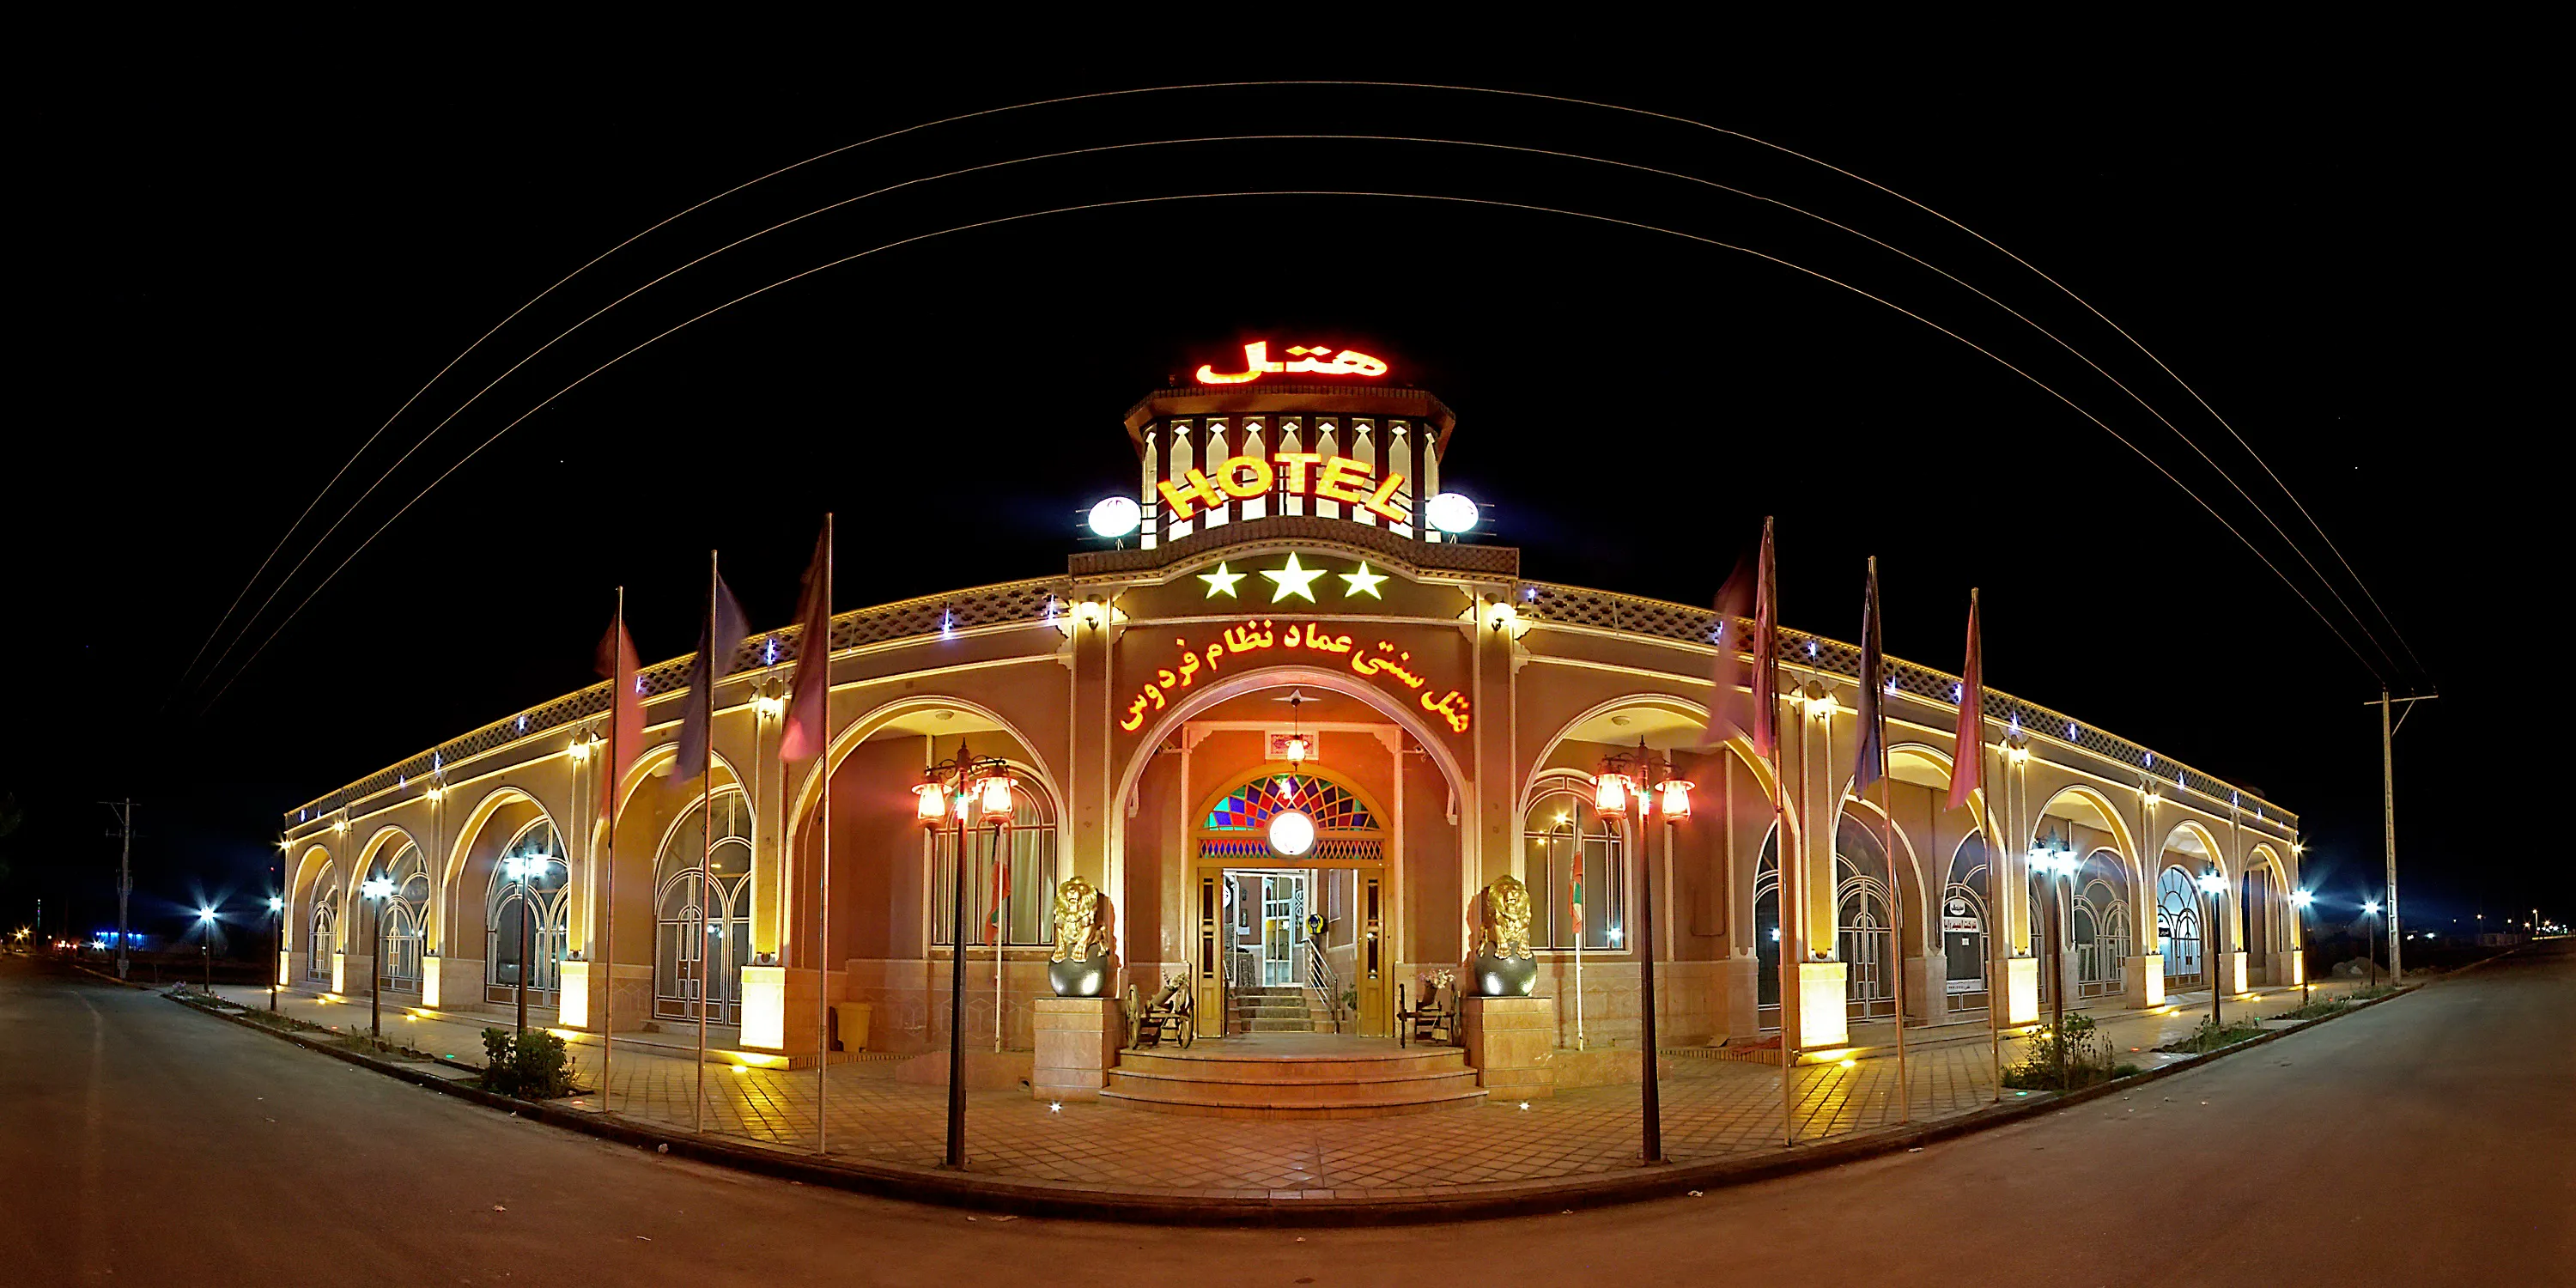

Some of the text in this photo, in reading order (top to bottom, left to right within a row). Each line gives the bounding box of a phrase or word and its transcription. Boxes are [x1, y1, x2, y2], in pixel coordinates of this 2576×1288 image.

[1195, 341, 1388, 384] هتل
[1157, 453, 1406, 525] HOTEL
[1120, 618, 1469, 732] هتل سنتی عماد نظام فردوس
